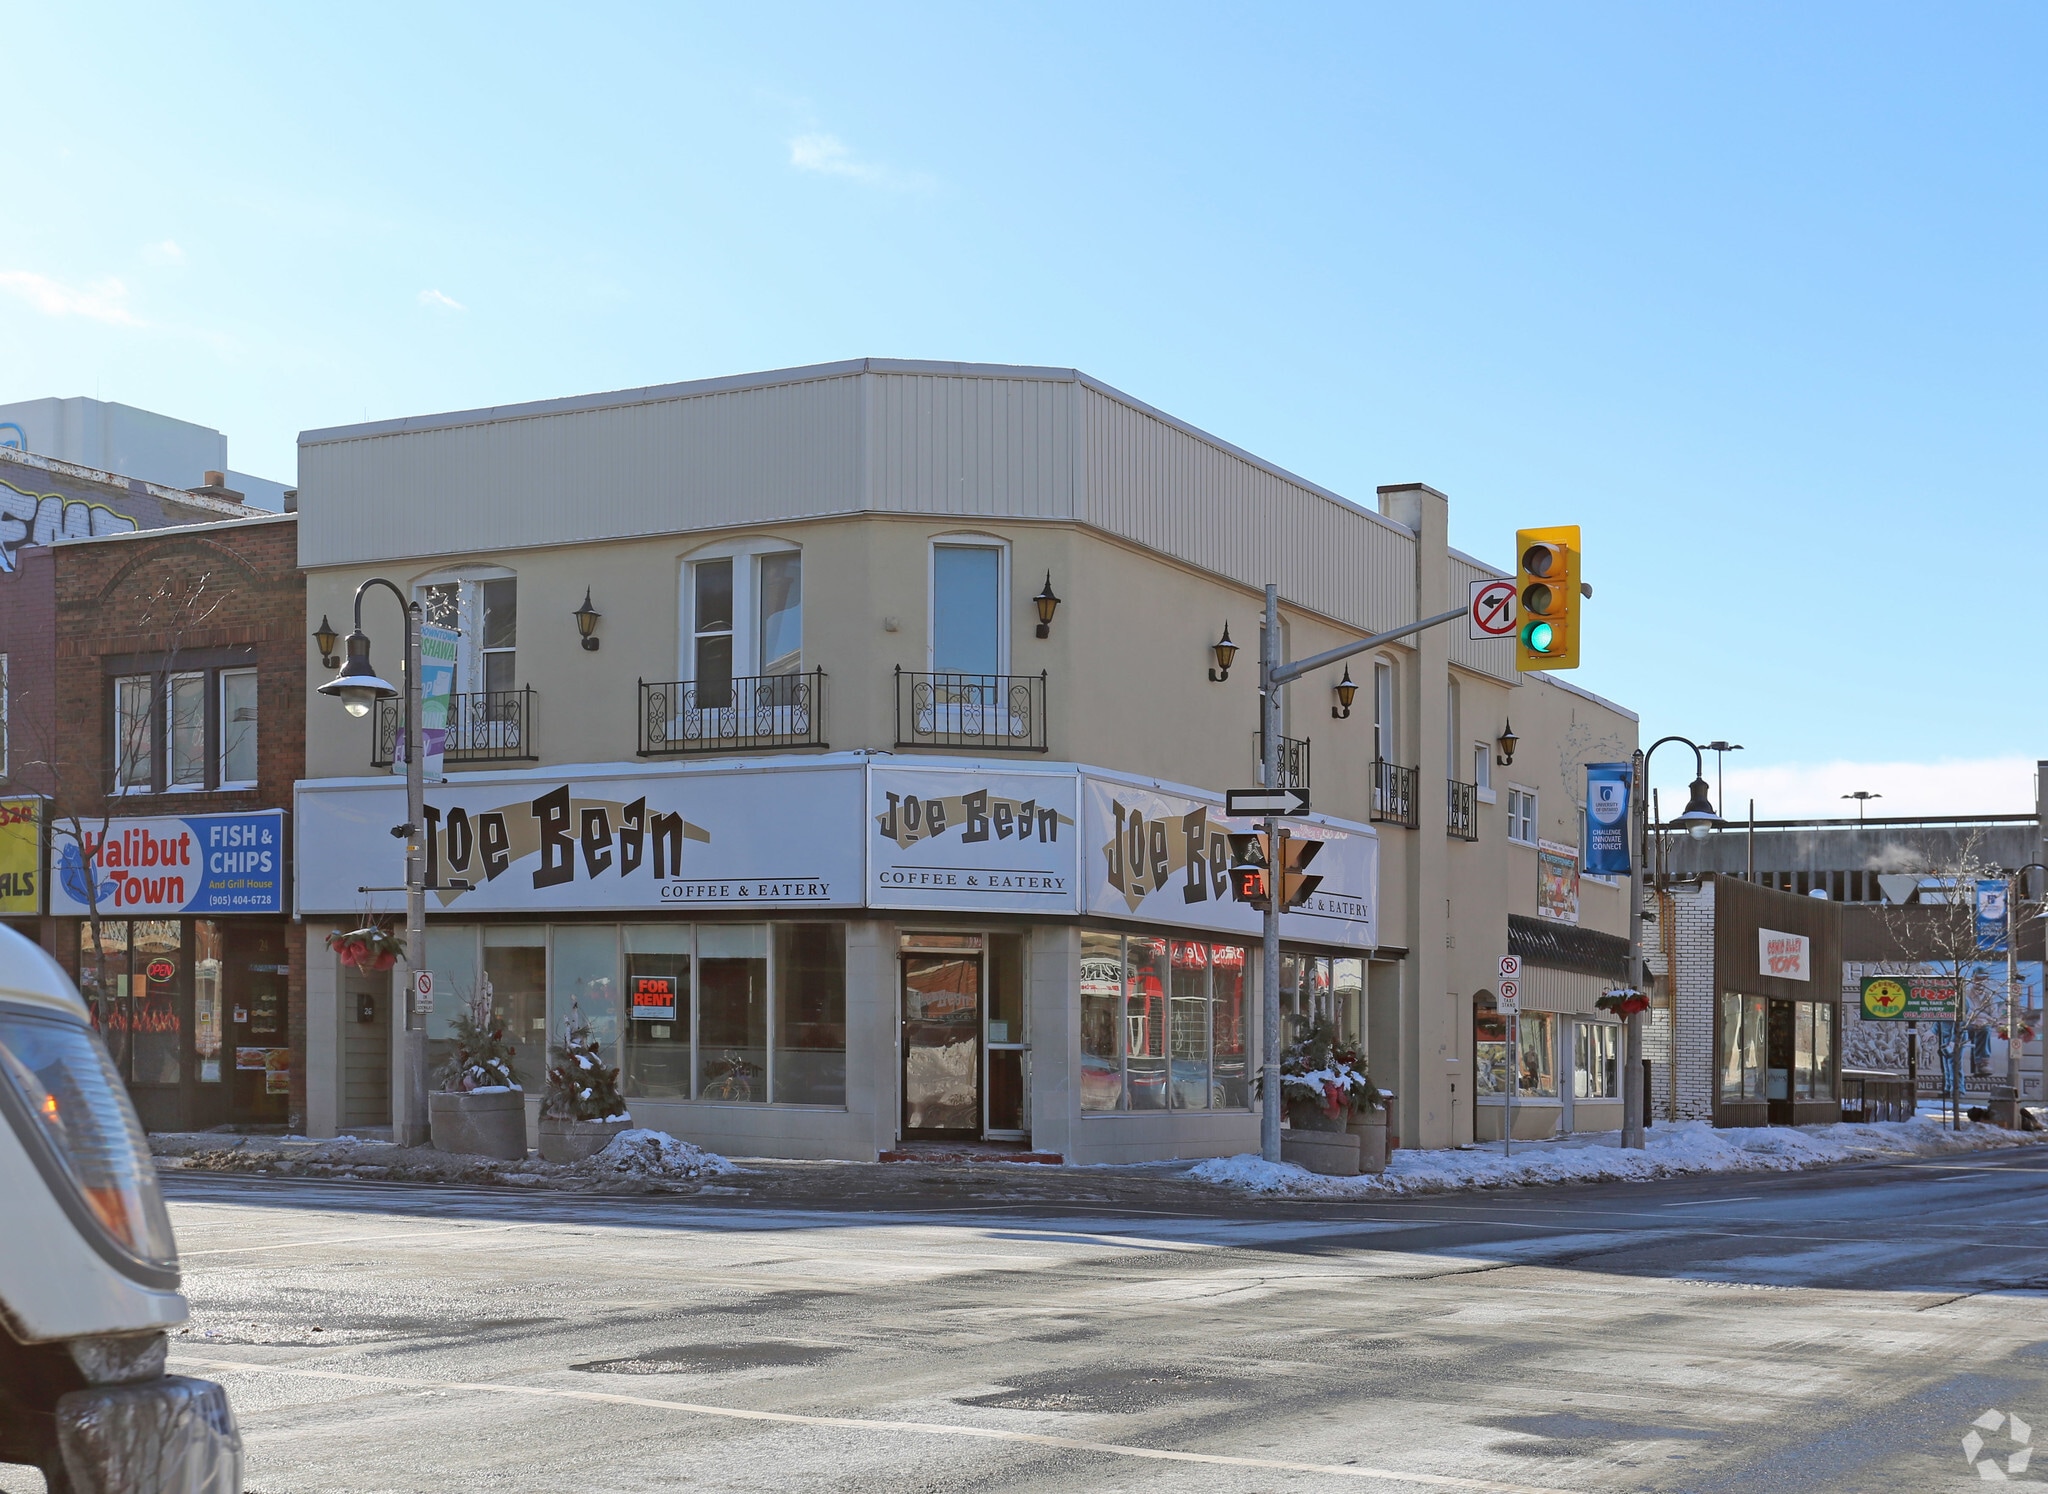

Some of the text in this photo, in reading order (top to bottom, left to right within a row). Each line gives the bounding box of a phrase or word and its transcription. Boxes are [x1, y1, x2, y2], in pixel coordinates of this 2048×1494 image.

[420, 637, 456, 661] SHAWA
[880, 788, 1057, 843] Joe Bean
[210, 825, 272, 847] FISH &
[532, 784, 683, 889] Bean
[84, 828, 190, 868] Halibut
[1108, 798, 1237, 904] Joe Be
[210, 850, 272, 873] CHIPS
[110, 871, 184, 907] Town
[209, 879, 273, 888] And Grill House
[880, 872, 1066, 889] COFFEE & EATERY
[661, 883, 831, 898] COFFEE & EATERY
[209, 894, 272, 906] (905) 404-6728
[1318, 899, 1325, 911] &
[1329, 901, 1368, 917] EATERY
[149, 963, 172, 977] OPEN
[638, 980, 669, 993] FOR
[1911, 987, 1957, 1001] PIZZA
[633, 993, 673, 1006] RENT
